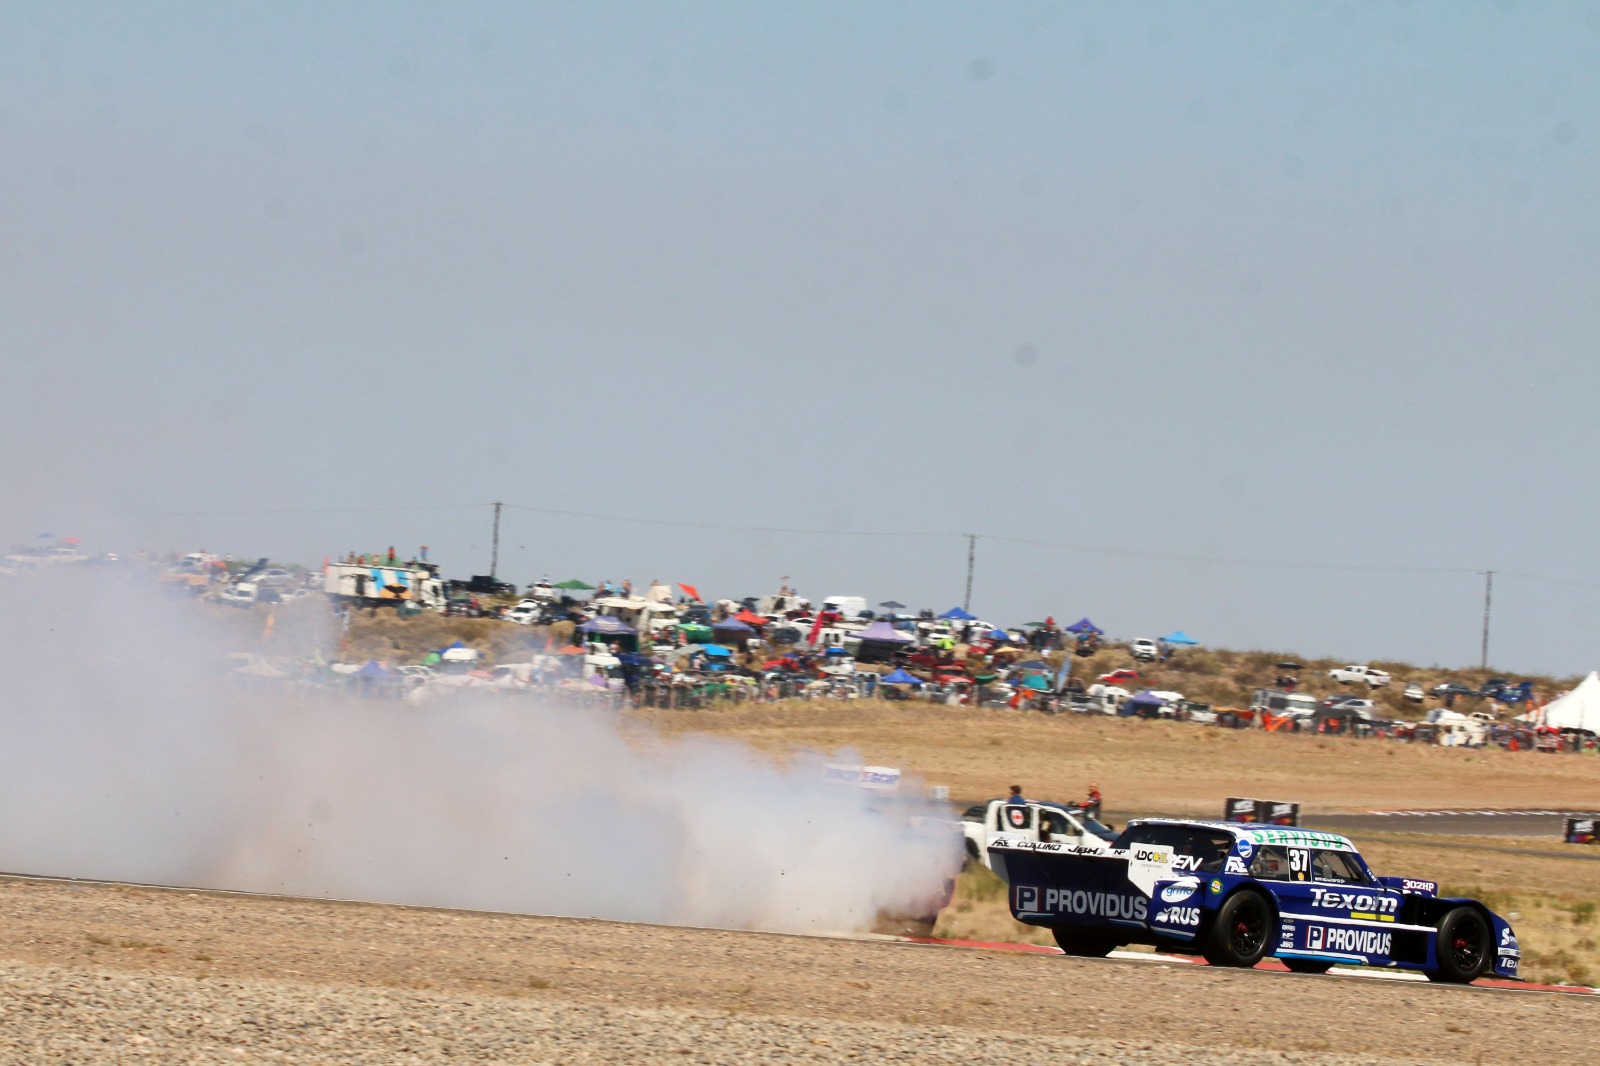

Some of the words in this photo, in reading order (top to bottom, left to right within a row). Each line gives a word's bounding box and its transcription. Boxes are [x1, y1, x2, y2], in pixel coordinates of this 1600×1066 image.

[1290, 849, 1309, 872] 37
[1402, 879, 1435, 893] 302HP
[1046, 888, 1148, 920] PROVIDUS
[1310, 888, 1397, 912] Texom
[1170, 906, 1201, 926] RUS
[1326, 928, 1392, 955] PROVIDUS
